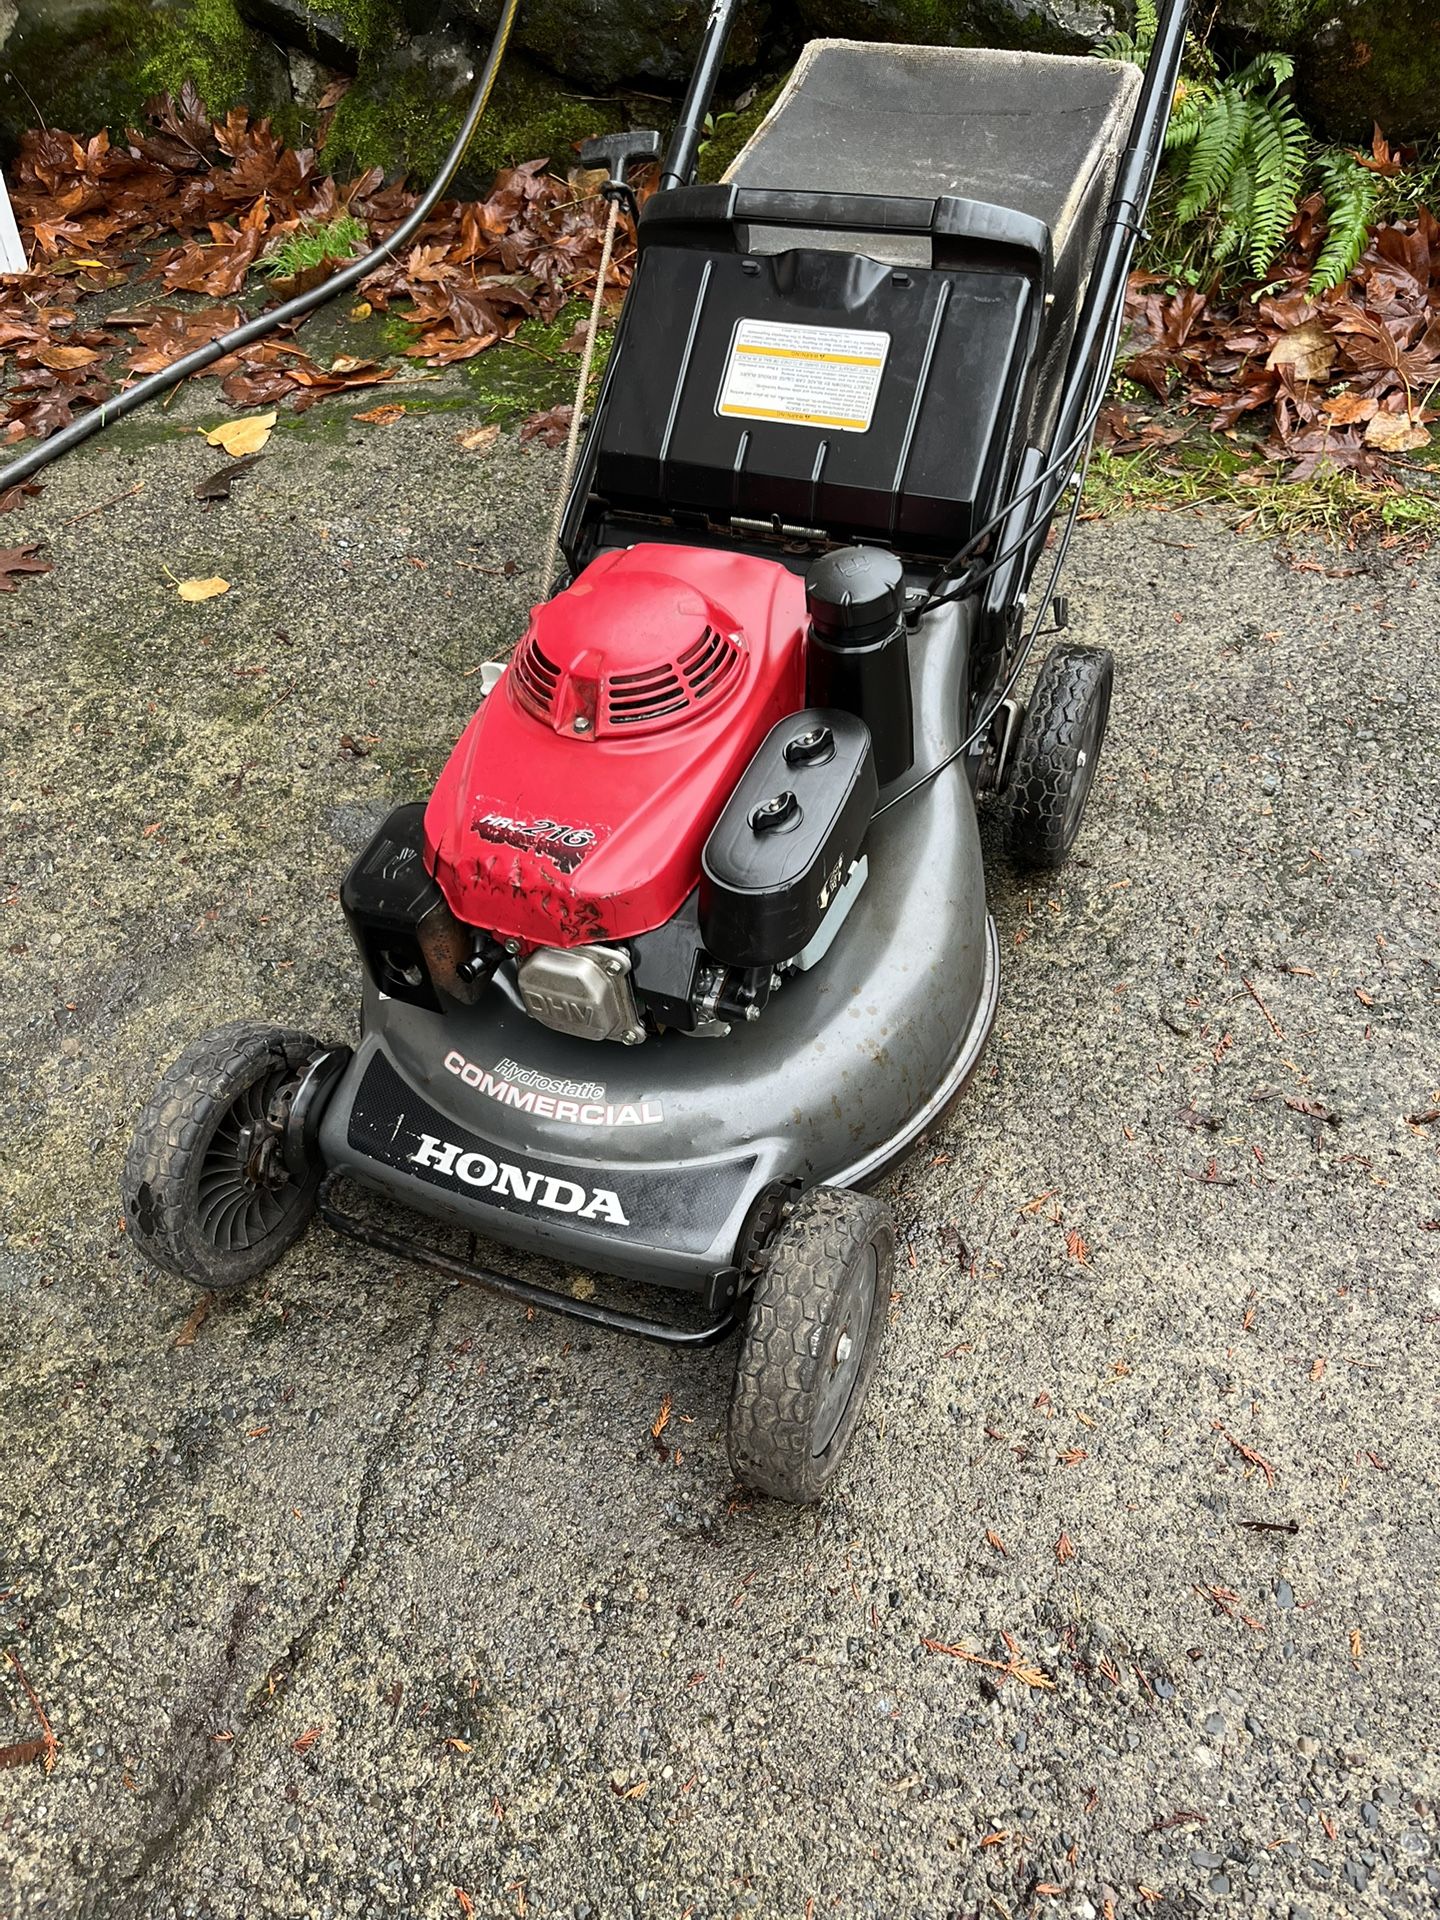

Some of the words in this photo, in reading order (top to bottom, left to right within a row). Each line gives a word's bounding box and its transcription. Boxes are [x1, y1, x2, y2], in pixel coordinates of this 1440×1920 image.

[443, 1049, 664, 1126] COMMERCIAL
[494, 1058, 605, 1100] Hydrostatic
[410, 1134, 630, 1226] HONDA
